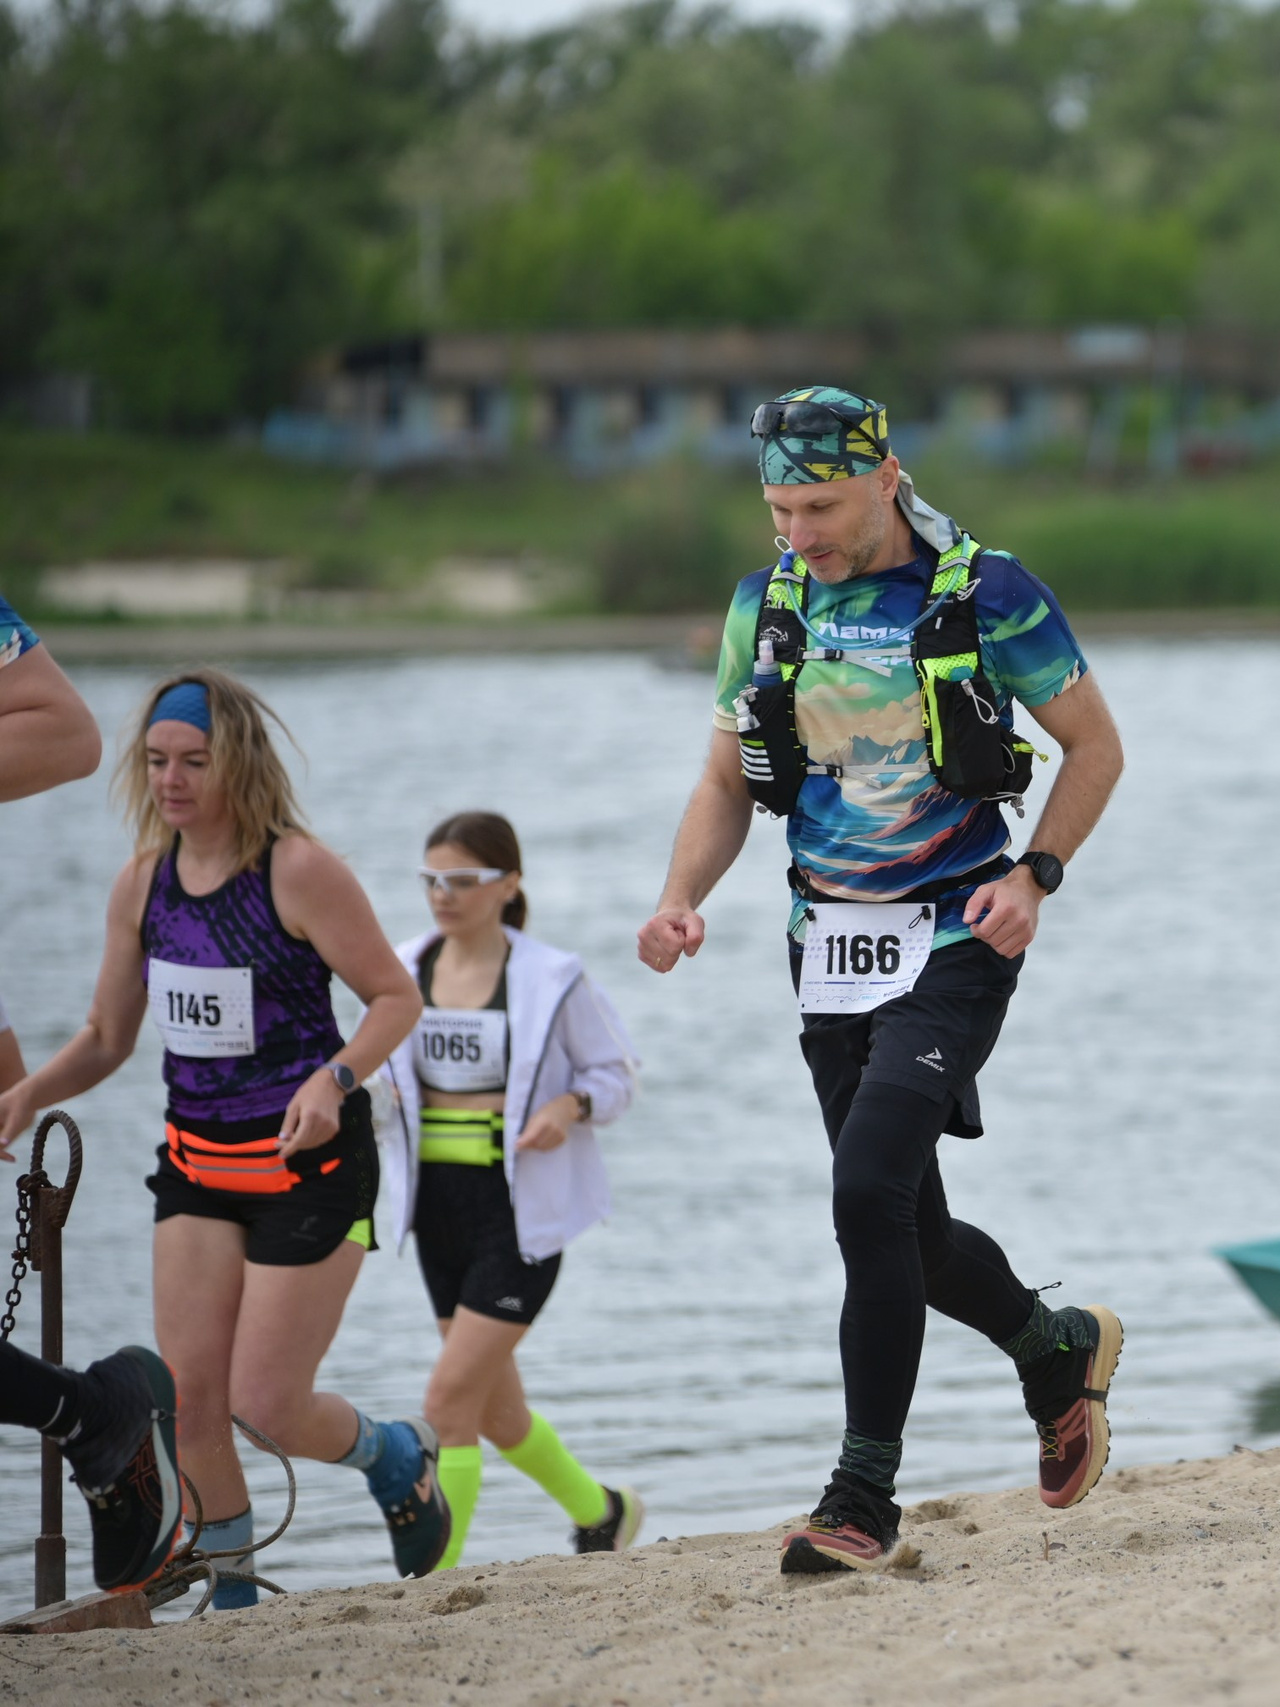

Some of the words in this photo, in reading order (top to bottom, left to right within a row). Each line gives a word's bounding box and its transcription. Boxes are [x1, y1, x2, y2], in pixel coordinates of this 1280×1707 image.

[826, 934, 901, 975] 1166
[166, 991, 221, 1026] 1145
[422, 1032, 482, 1062] 1065
[915, 1055, 946, 1073] DEMIX
